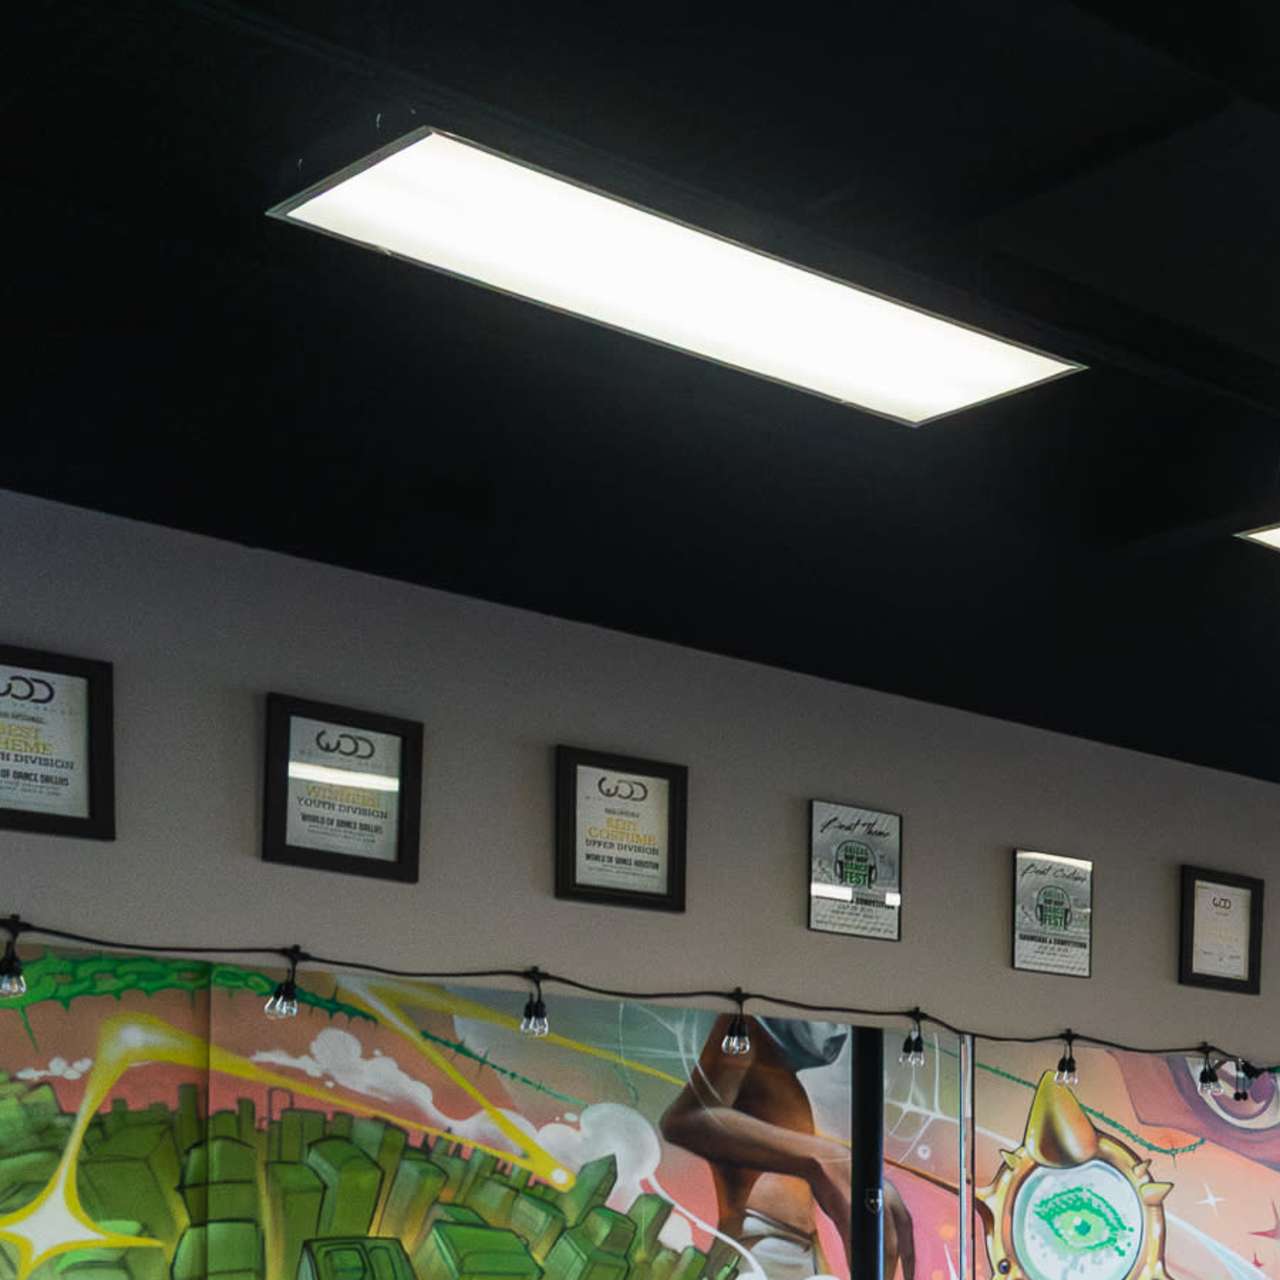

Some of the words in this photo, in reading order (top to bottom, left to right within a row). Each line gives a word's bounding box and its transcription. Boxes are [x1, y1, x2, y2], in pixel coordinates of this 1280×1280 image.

[14, 755, 75, 771] DIVISION
[297, 796, 336, 811] YOUTH
[338, 803, 388, 820] DIVISION
[617, 842, 660, 856] DIVISION
